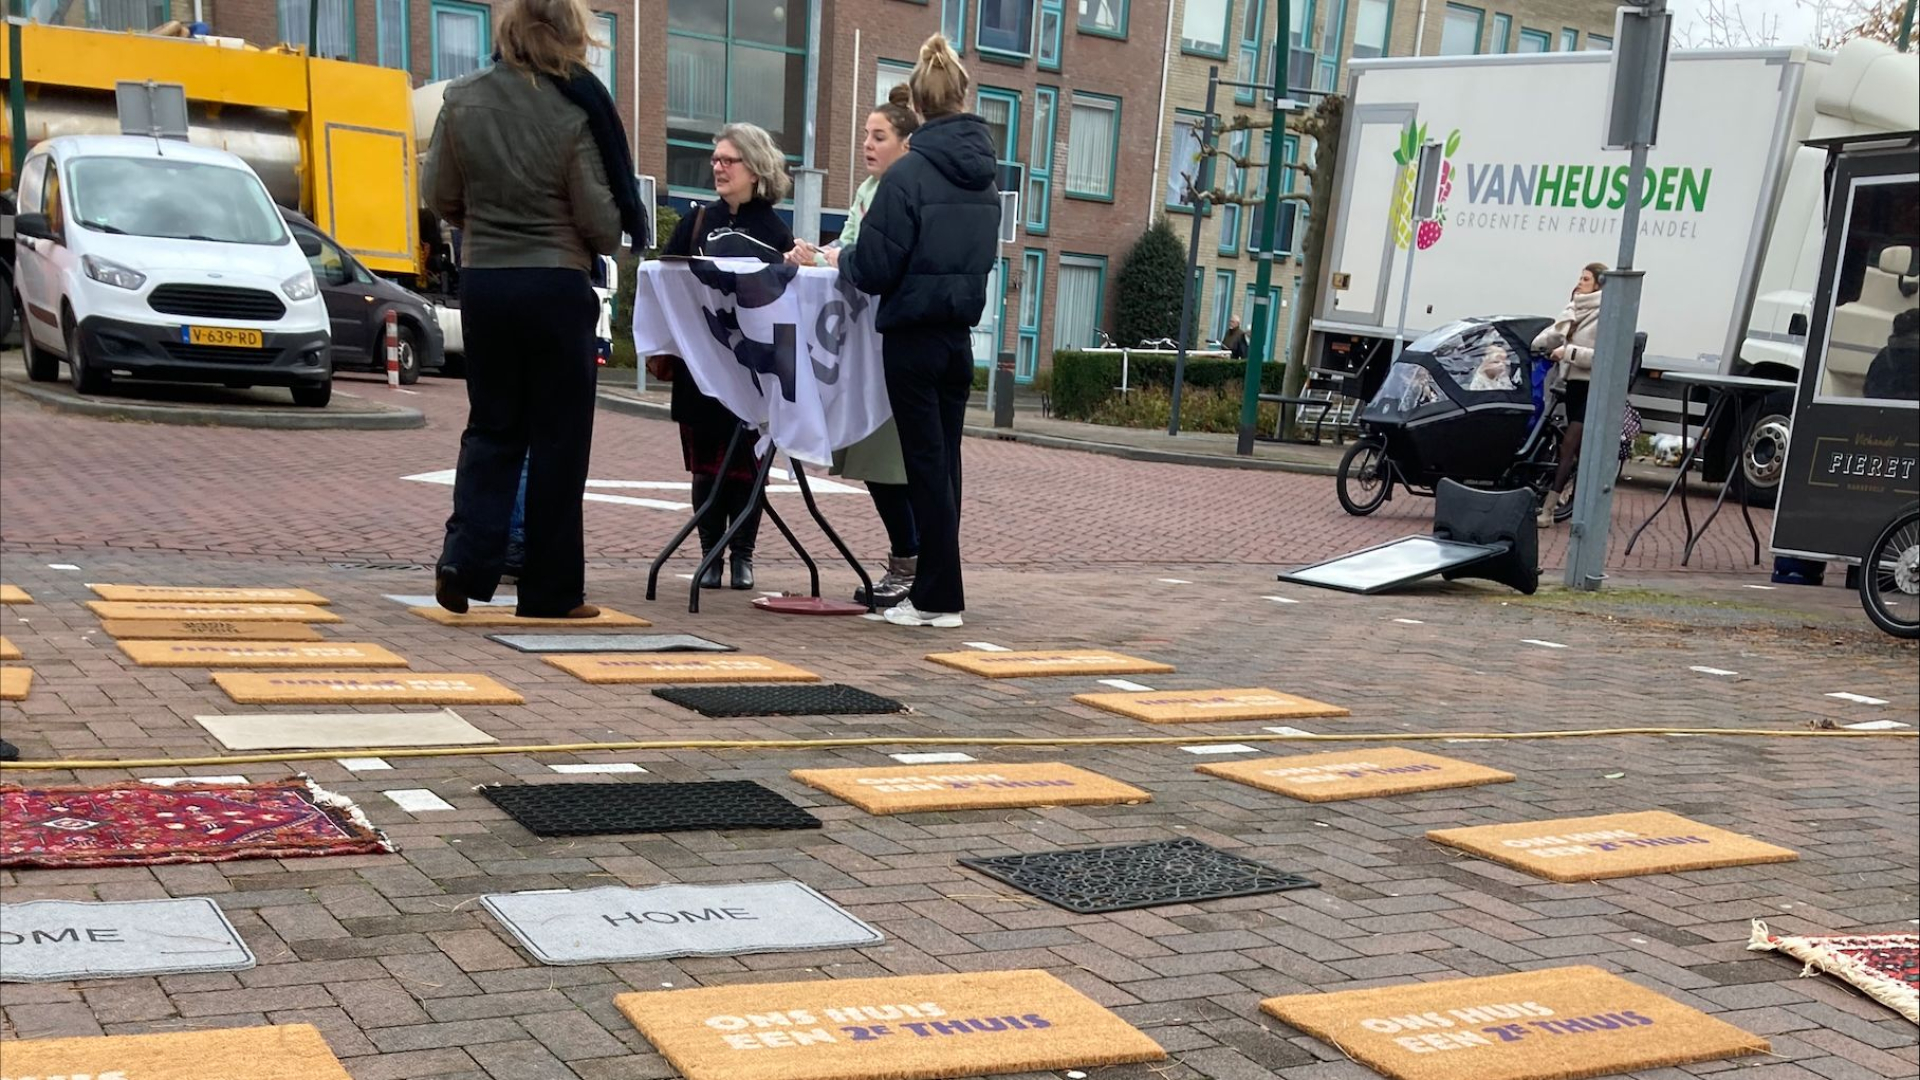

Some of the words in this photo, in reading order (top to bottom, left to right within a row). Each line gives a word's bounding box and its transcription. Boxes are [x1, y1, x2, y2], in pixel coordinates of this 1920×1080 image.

[1456, 211, 1529, 230] GROENTE
[1538, 215, 1560, 231] EN
[1639, 219, 1698, 239] ANDEL
[192, 328, 257, 345] V-639-RD
[1828, 451, 1916, 480] FIERET
[601, 907, 759, 927] HOME
[0, 927, 125, 945] OME
[703, 1008, 818, 1030] ONS
[823, 1001, 947, 1023] HUIS
[1360, 1011, 1455, 1033] ONS
[1448, 1001, 1555, 1024] HUIS
[720, 1027, 838, 1050] EEN
[899, 1013, 1053, 1037] THUIS
[1393, 1030, 1494, 1053] EEN
[1527, 1010, 1655, 1035] THUIS
